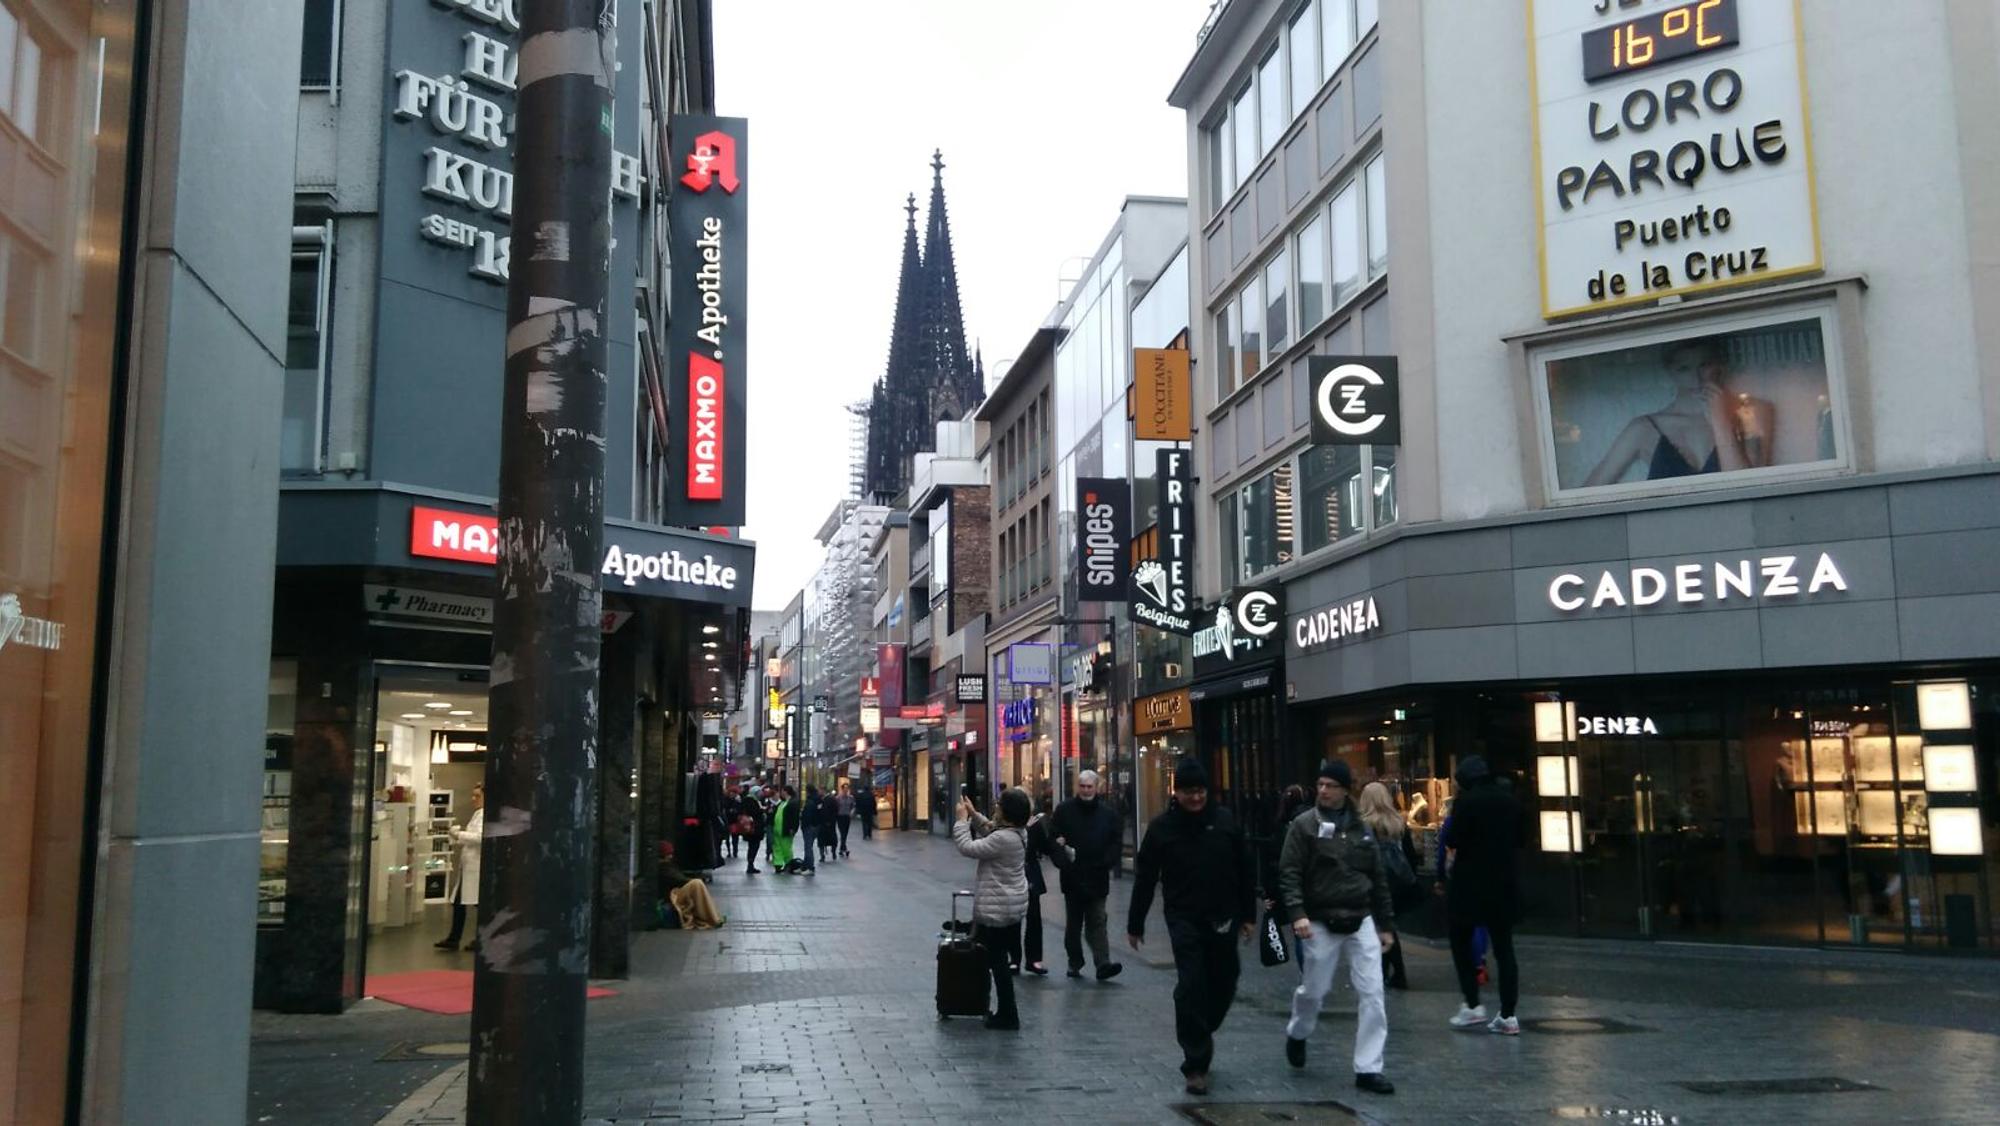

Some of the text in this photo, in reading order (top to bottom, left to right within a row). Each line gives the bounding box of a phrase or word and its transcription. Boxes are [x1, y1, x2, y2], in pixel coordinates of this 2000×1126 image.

[394, 69, 508, 148] FÜR
[1588, 68, 1743, 142] LORO
[1556, 119, 1788, 212] PARQUE
[422, 213, 478, 248] SEIT
[1614, 204, 1732, 251] Puerto
[697, 216, 727, 345] Apotheke
[1587, 246, 1769, 302] de la Cruz
[695, 375, 717, 483] MAXMO
[1086, 503, 1120, 586] snipes
[1166, 453, 1187, 613] FRITES
[601, 544, 737, 590] Apotheke
[1549, 552, 1847, 612] CADENZA
[404, 594, 490, 620] Pharmacy
[1134, 602, 1191, 631] Belgique
[1296, 594, 1380, 649] CADENZA
[958, 677, 983, 685] LUSH
[1268, 917, 1285, 961] adidas
